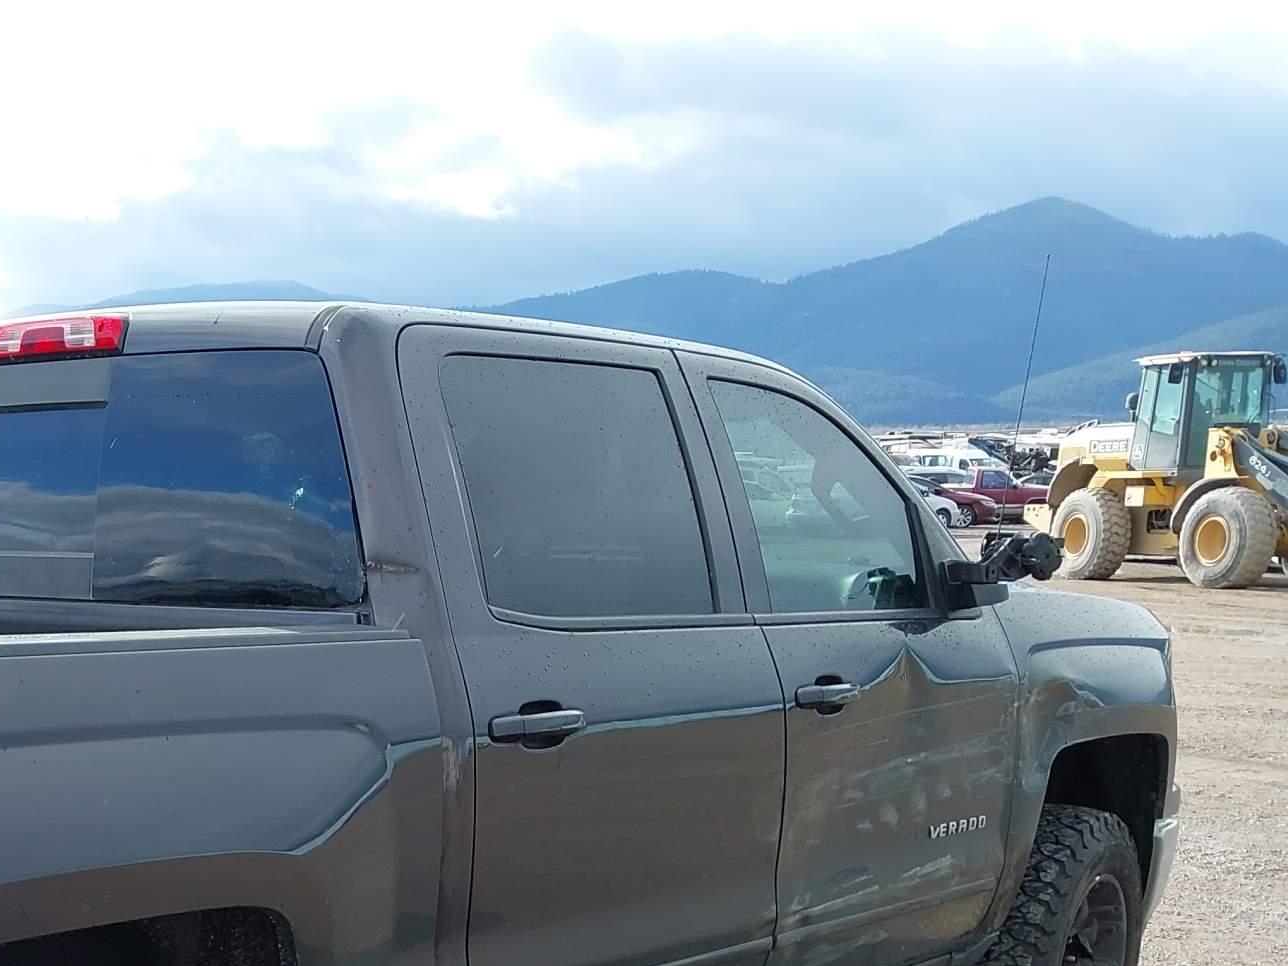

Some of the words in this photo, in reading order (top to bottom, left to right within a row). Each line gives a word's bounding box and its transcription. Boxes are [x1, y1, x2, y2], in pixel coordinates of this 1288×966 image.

[1090, 440, 1128, 452] DEERE
[1248, 455, 1272, 478] 624J
[929, 814, 988, 840] VERADO
